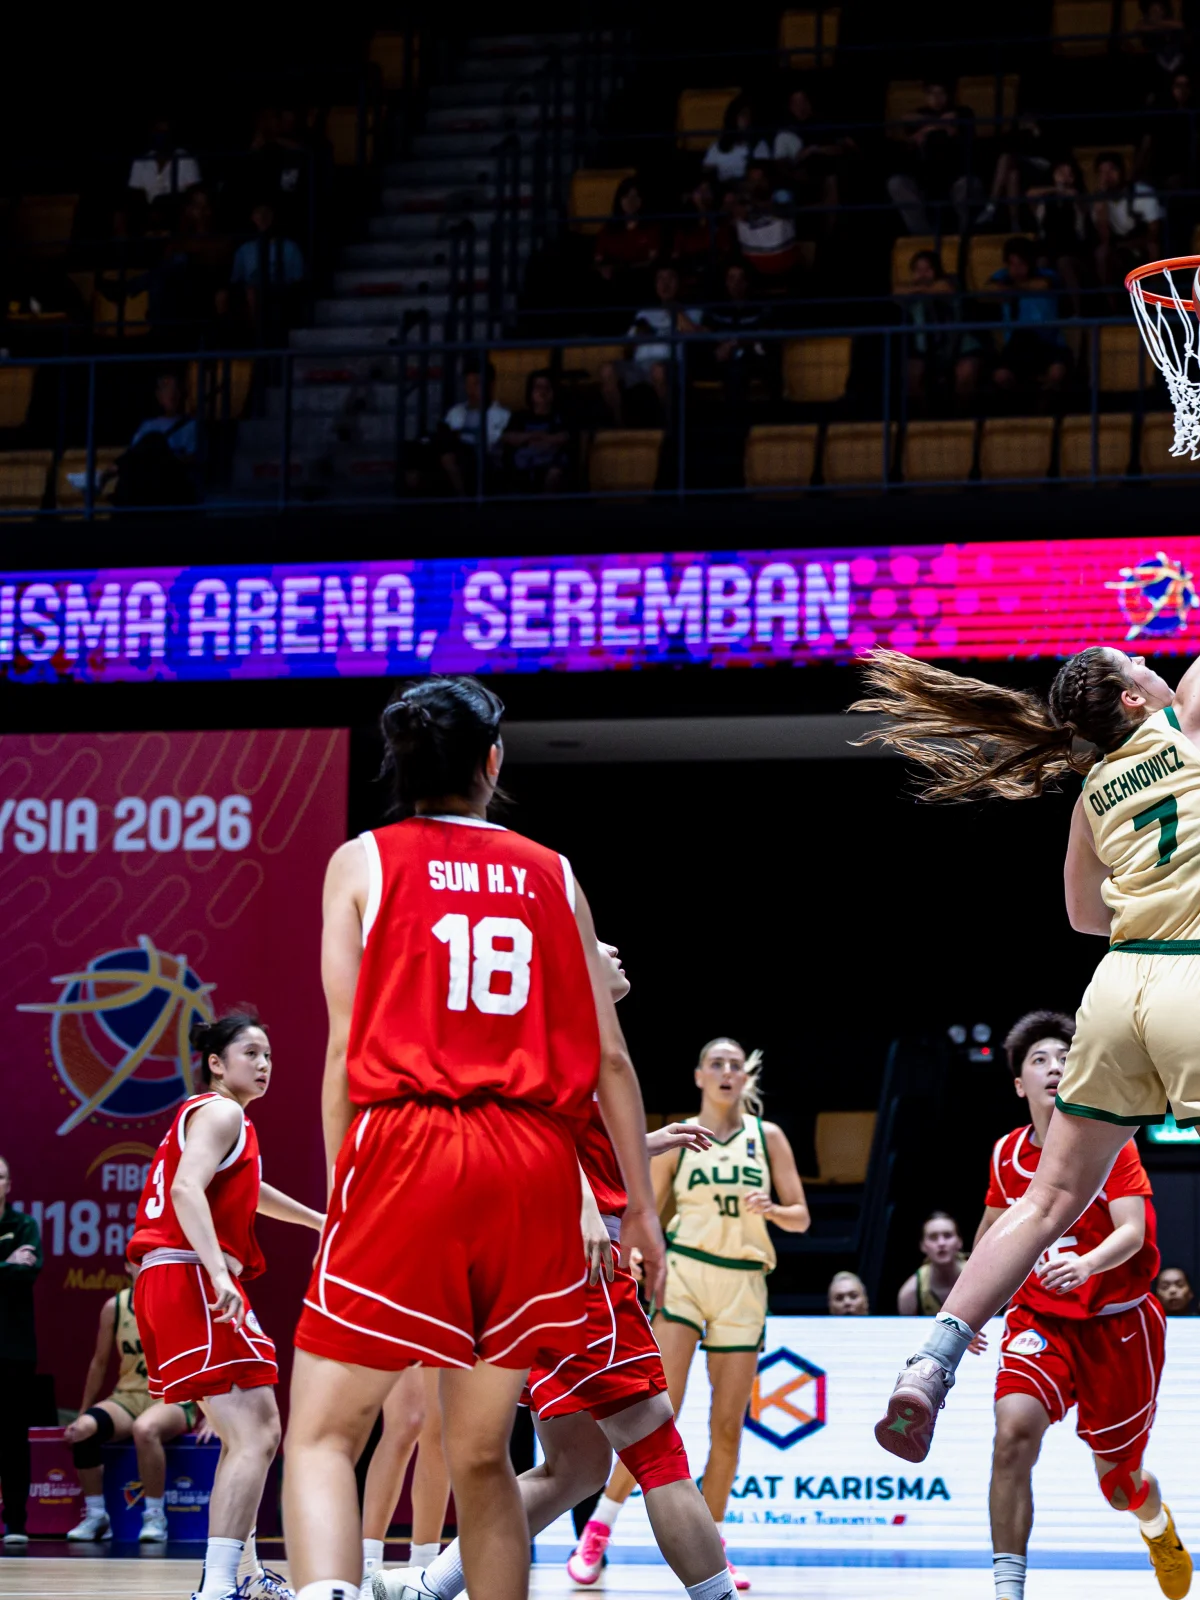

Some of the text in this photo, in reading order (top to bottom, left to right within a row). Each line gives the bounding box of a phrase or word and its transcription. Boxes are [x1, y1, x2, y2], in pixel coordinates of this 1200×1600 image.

[189, 574, 437, 658] ARENA,
[462, 562, 850, 650] SEREMBAN
[1089, 745, 1185, 817] OLECHNOWICZ
[113, 795, 252, 852] 2026
[1132, 794, 1179, 868] 7
[428, 860, 536, 899] SUN H.Y.
[431, 913, 533, 1015] 18
[688, 1165, 763, 1190] AUS
[714, 1194, 740, 1218] 10
[795, 1477, 950, 1501] KARISMA
